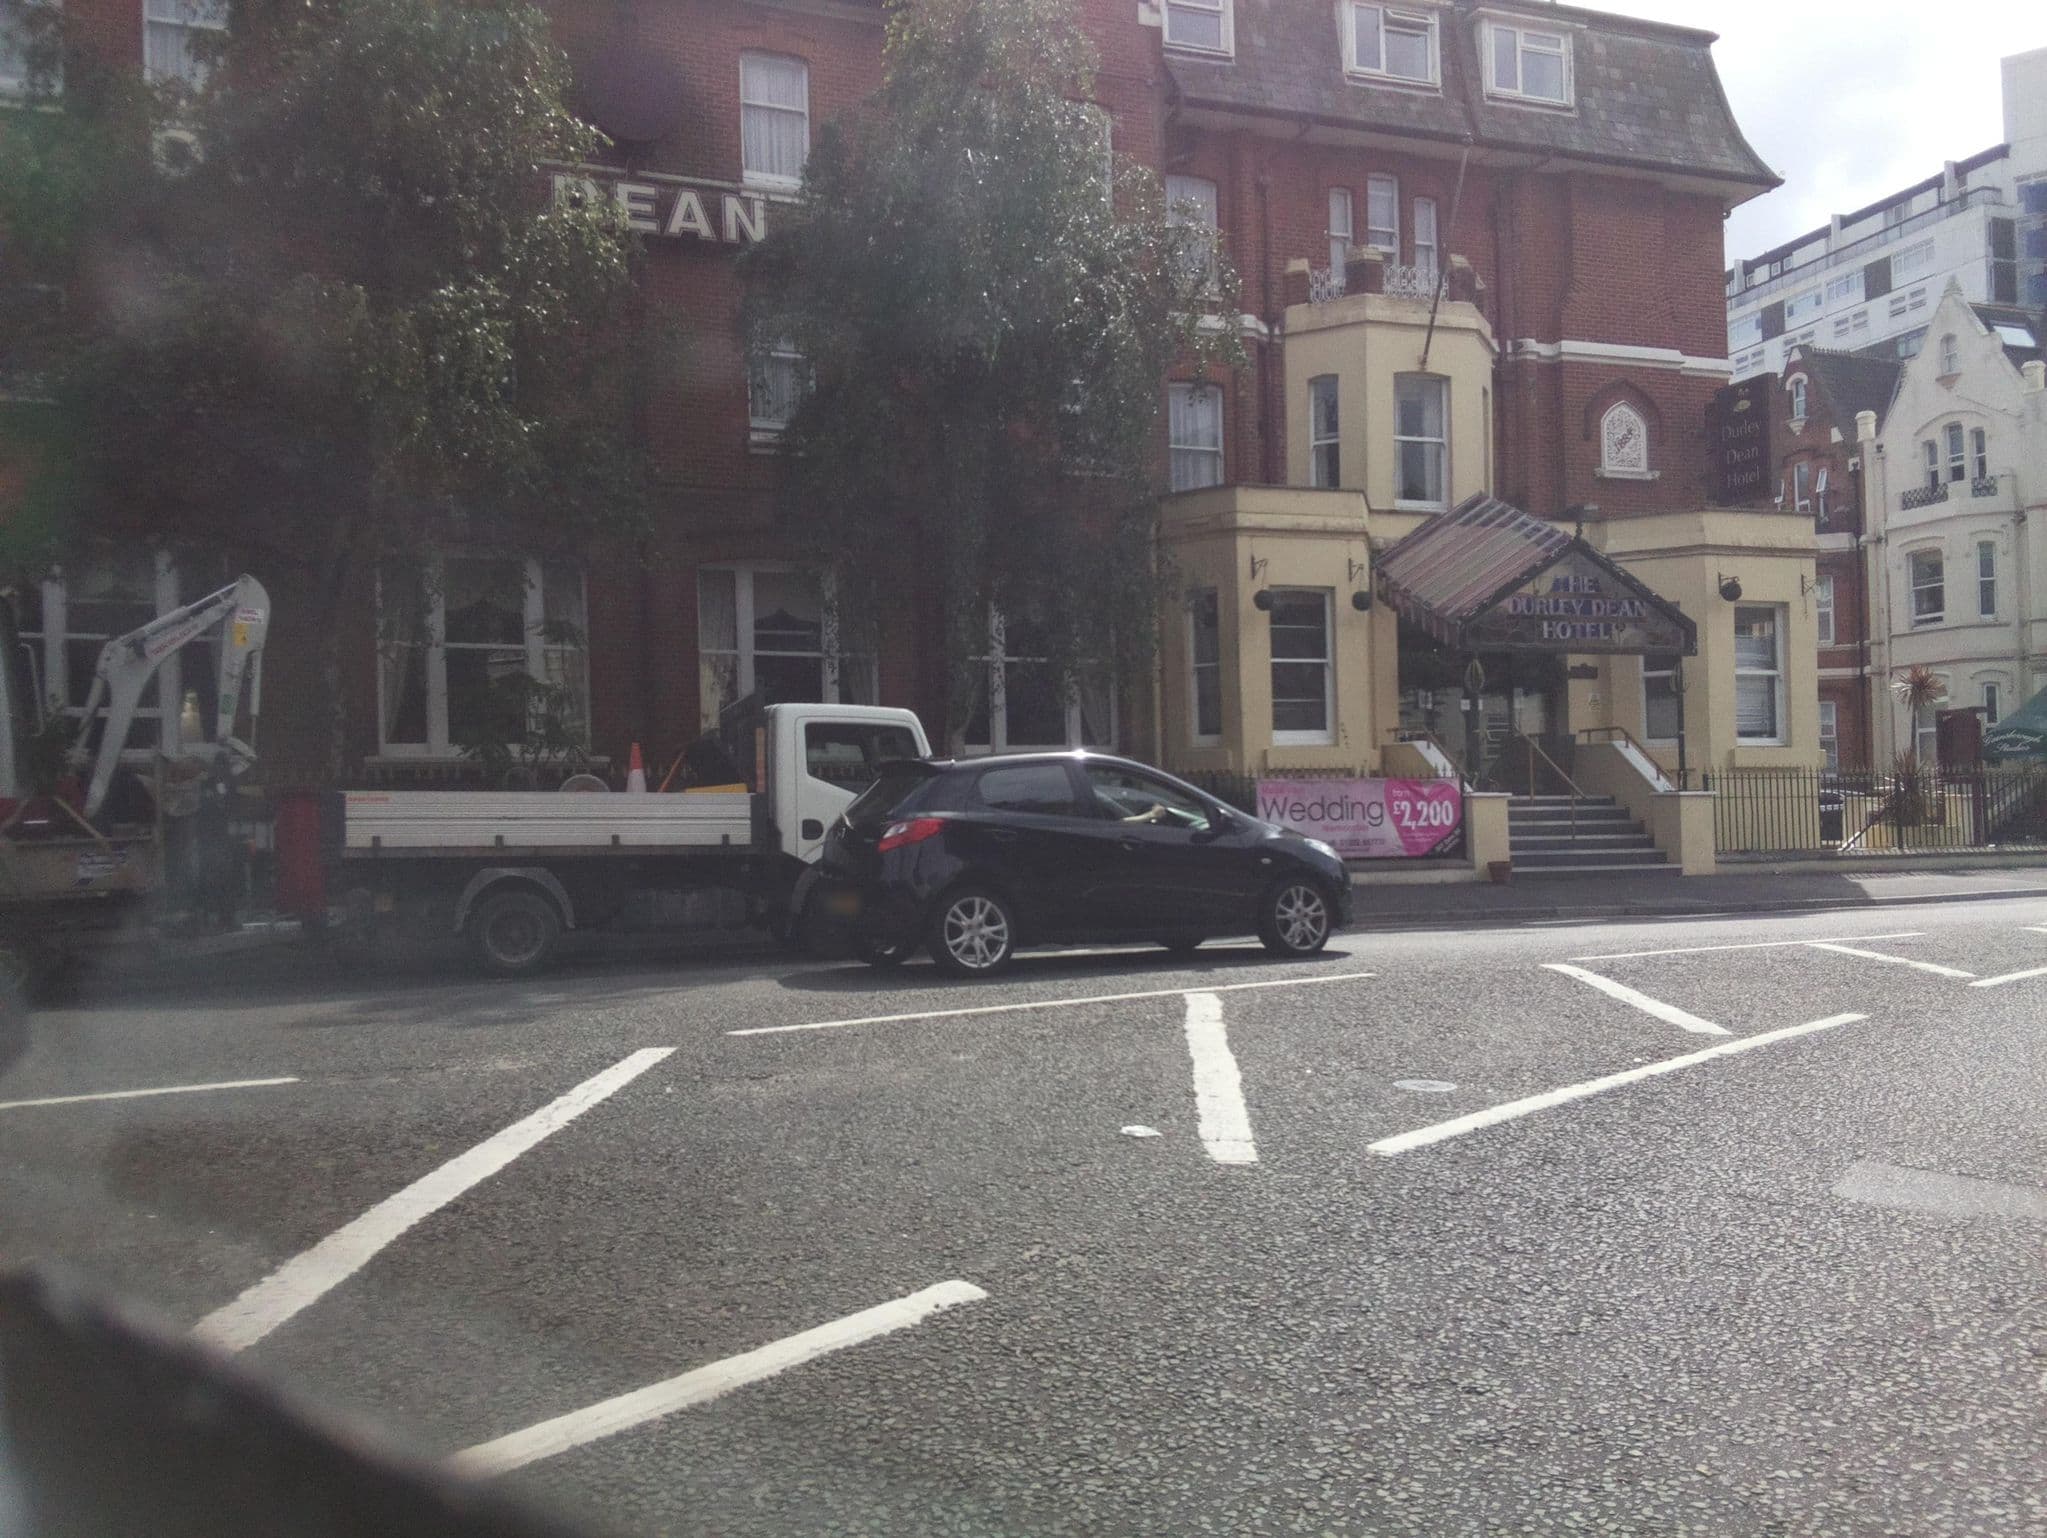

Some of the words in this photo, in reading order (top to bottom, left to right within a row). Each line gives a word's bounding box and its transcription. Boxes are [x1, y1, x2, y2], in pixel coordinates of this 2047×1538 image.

[551, 173, 767, 244] DEAN
[1721, 418, 1760, 441] Durley
[1726, 445, 1759, 465] Dean
[1727, 463, 1760, 489] Hotel
[1554, 575, 1598, 593] THE
[1508, 598, 1583, 616] DURLEY
[1591, 599, 1647, 617] DEAN
[1542, 620, 1610, 640] HOTEL
[1391, 789, 1411, 798] from
[1260, 794, 1385, 827] Wedding
[1392, 799, 1454, 830] £2,200
